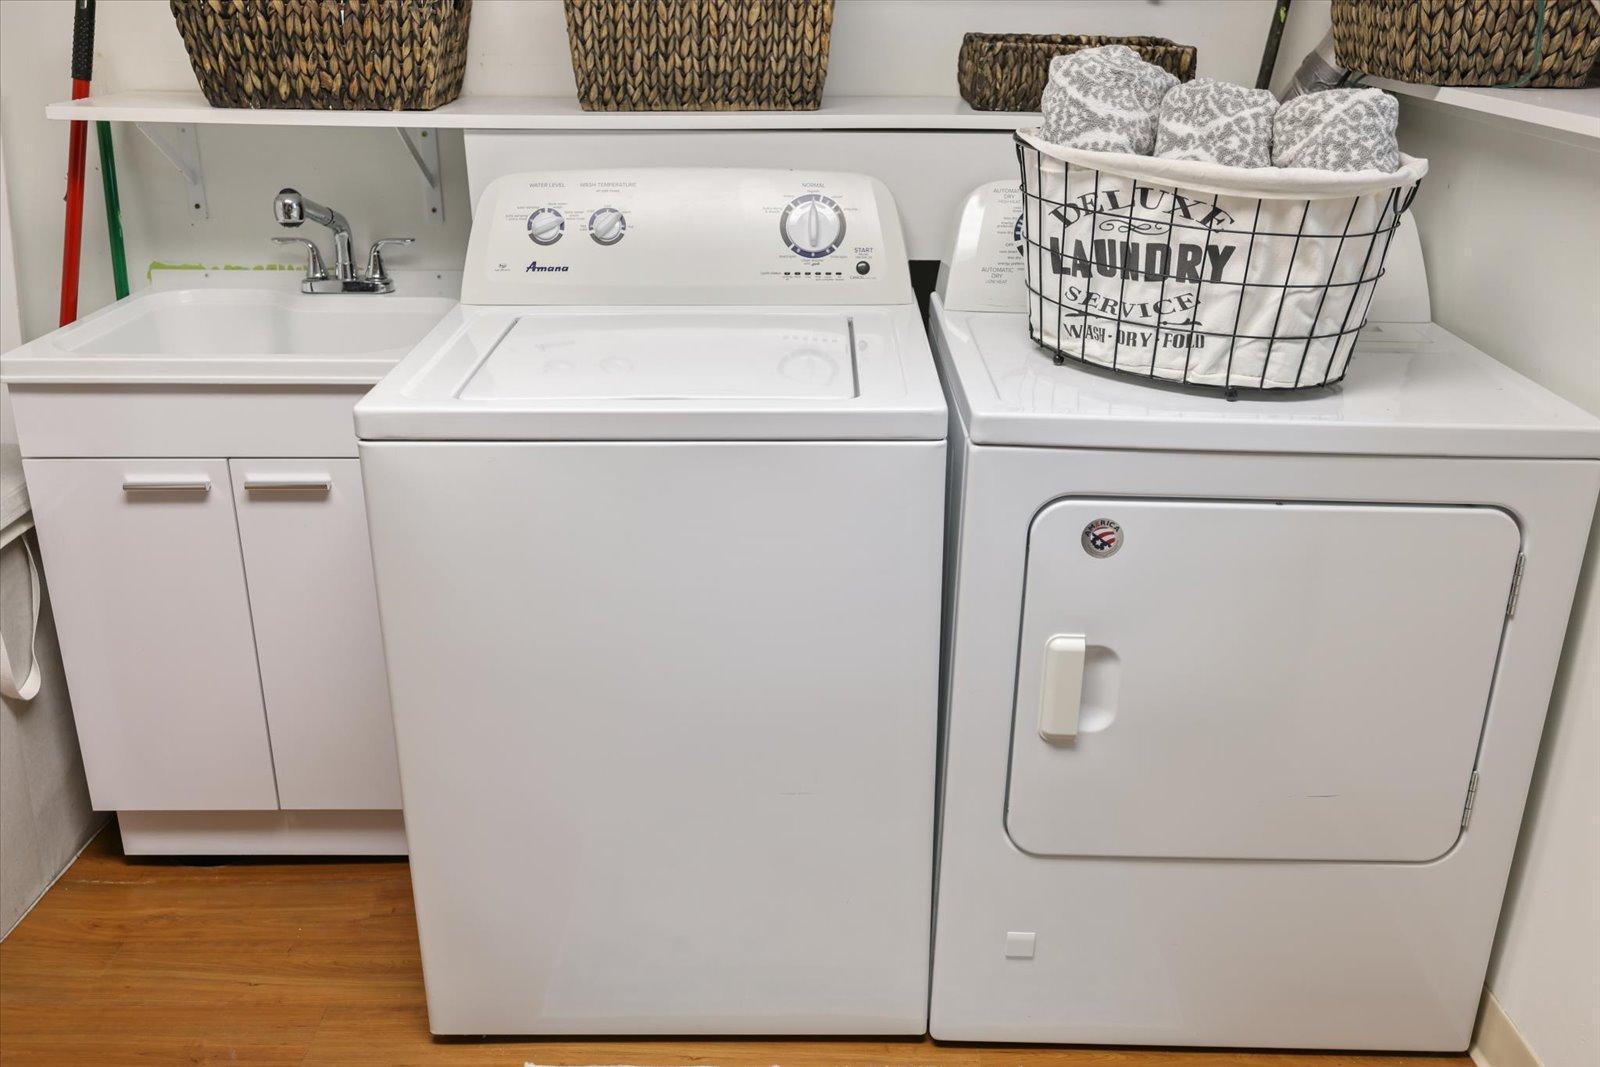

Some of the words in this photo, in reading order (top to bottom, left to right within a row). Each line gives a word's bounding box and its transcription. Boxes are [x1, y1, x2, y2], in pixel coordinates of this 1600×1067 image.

[1048, 187, 1235, 233] DELUXE
[526, 261, 569, 272] Amana
[1049, 236, 1236, 284] LAUNDRY
[1064, 285, 1202, 318] SERVICE
[1063, 323, 1106, 343] WASH
[1117, 329, 1153, 347] DRY
[1162, 332, 1206, 349] FOLD
[1085, 520, 1120, 537] AMERICA
